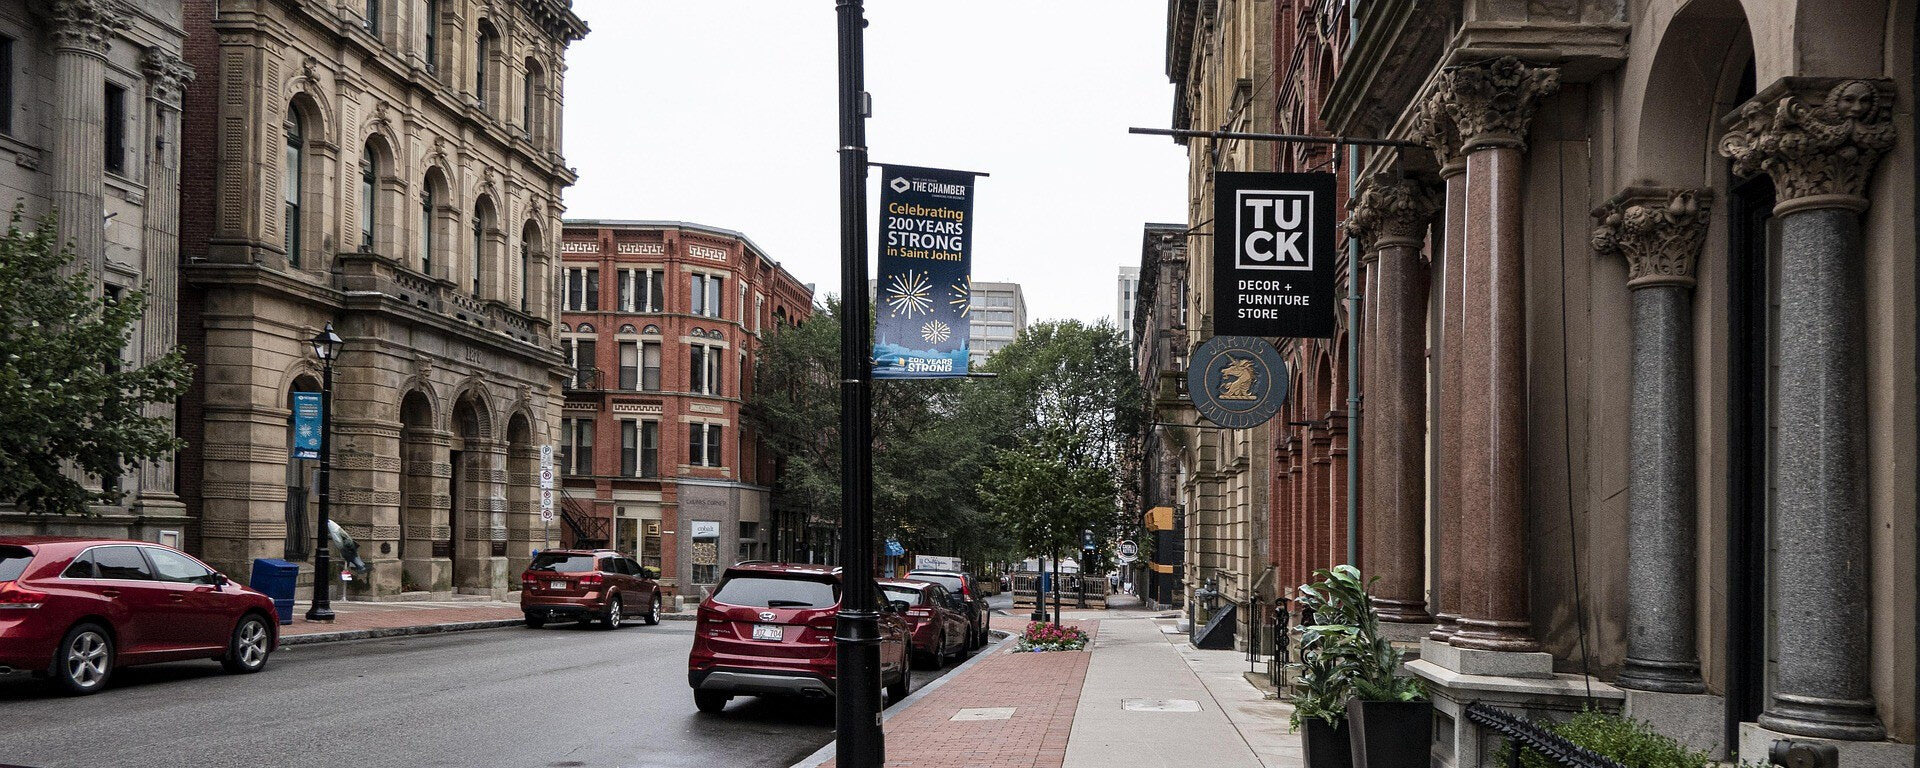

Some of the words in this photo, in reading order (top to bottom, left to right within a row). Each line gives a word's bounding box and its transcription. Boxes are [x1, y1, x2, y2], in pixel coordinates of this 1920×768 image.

[912, 181, 927, 192] THE
[927, 183, 966, 196] CHAMBER
[889, 202, 964, 222] Celebrating
[887, 216, 914, 231] 200
[916, 219, 963, 235] YEARS
[887, 230, 963, 251] STRONG
[887, 246, 898, 256] in
[900, 247, 929, 259] Saint
[931, 250, 962, 261] John!
[1238, 280, 1280, 291] DECOR
[1238, 294, 1310, 306] FURNITURE
[1238, 308, 1278, 319] STORE
[1208, 336, 1267, 355] JARVIS
[907, 363, 953, 372] STRONG
[1200, 401, 1277, 428] BUILDING
[769, 629, 782, 638] 704
